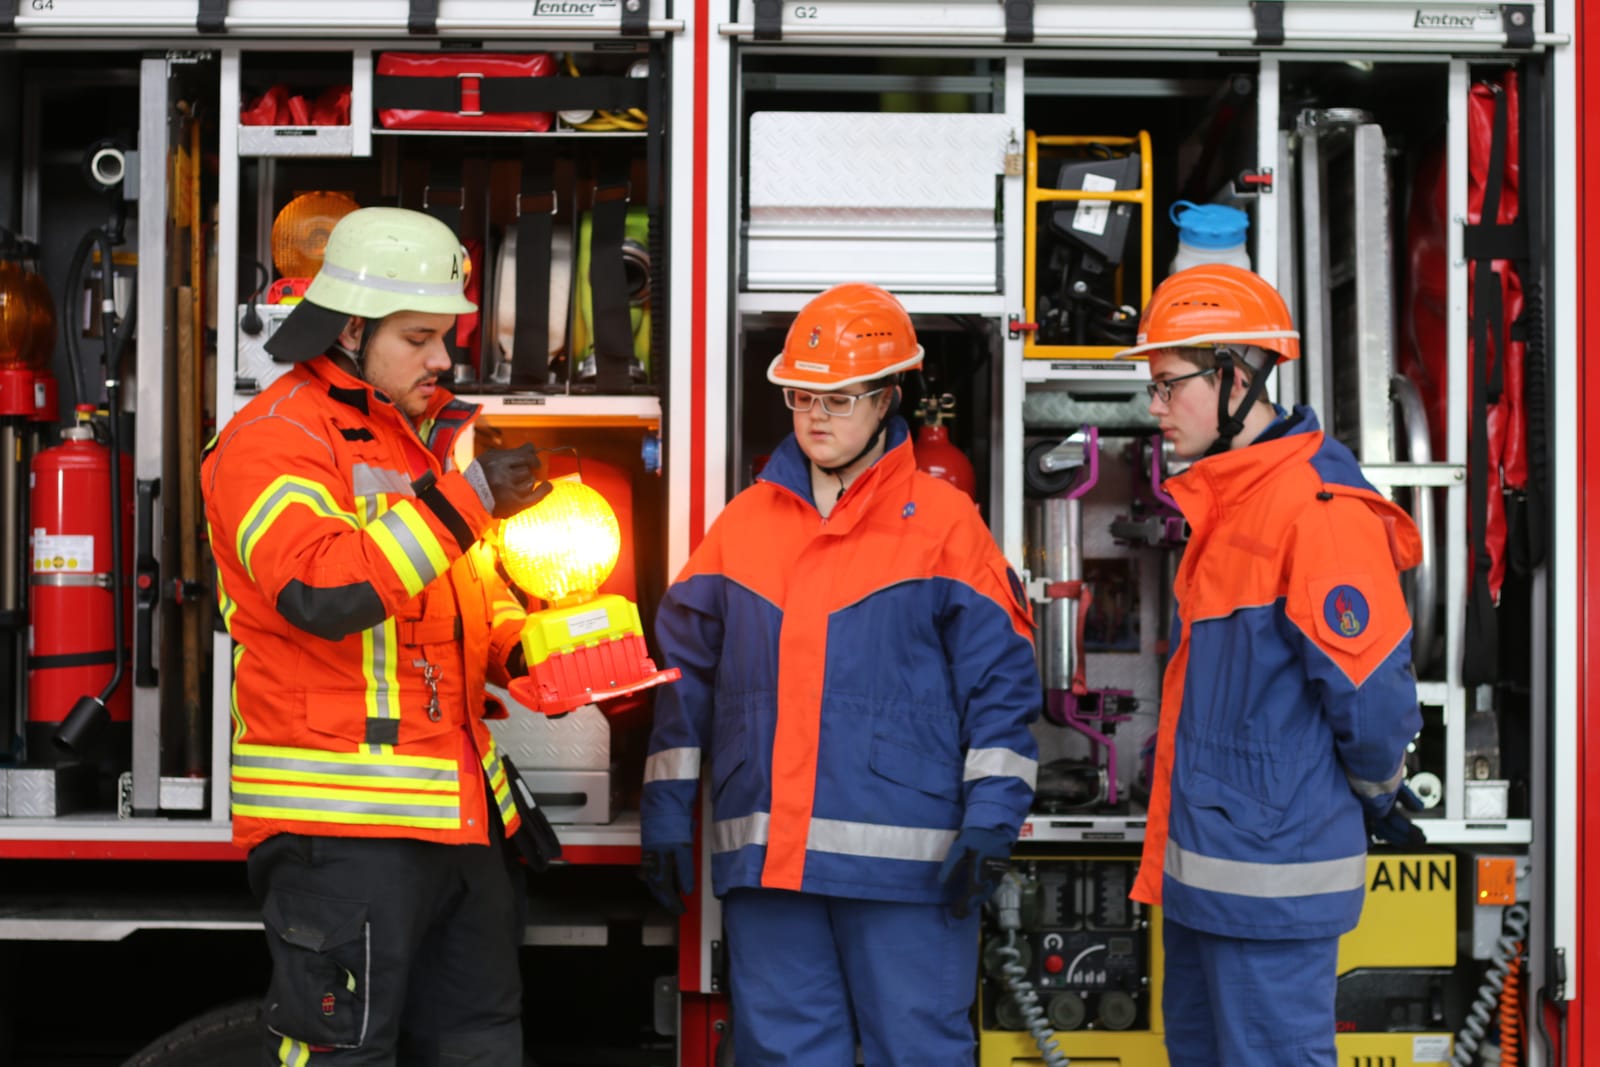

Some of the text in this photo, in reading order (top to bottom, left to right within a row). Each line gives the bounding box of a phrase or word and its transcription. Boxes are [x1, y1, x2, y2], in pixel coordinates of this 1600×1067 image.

[32, 0, 54, 10] G4
[533, 0, 597, 16] Lentner
[794, 6, 818, 19] G2
[1414, 9, 1476, 29] Lentner
